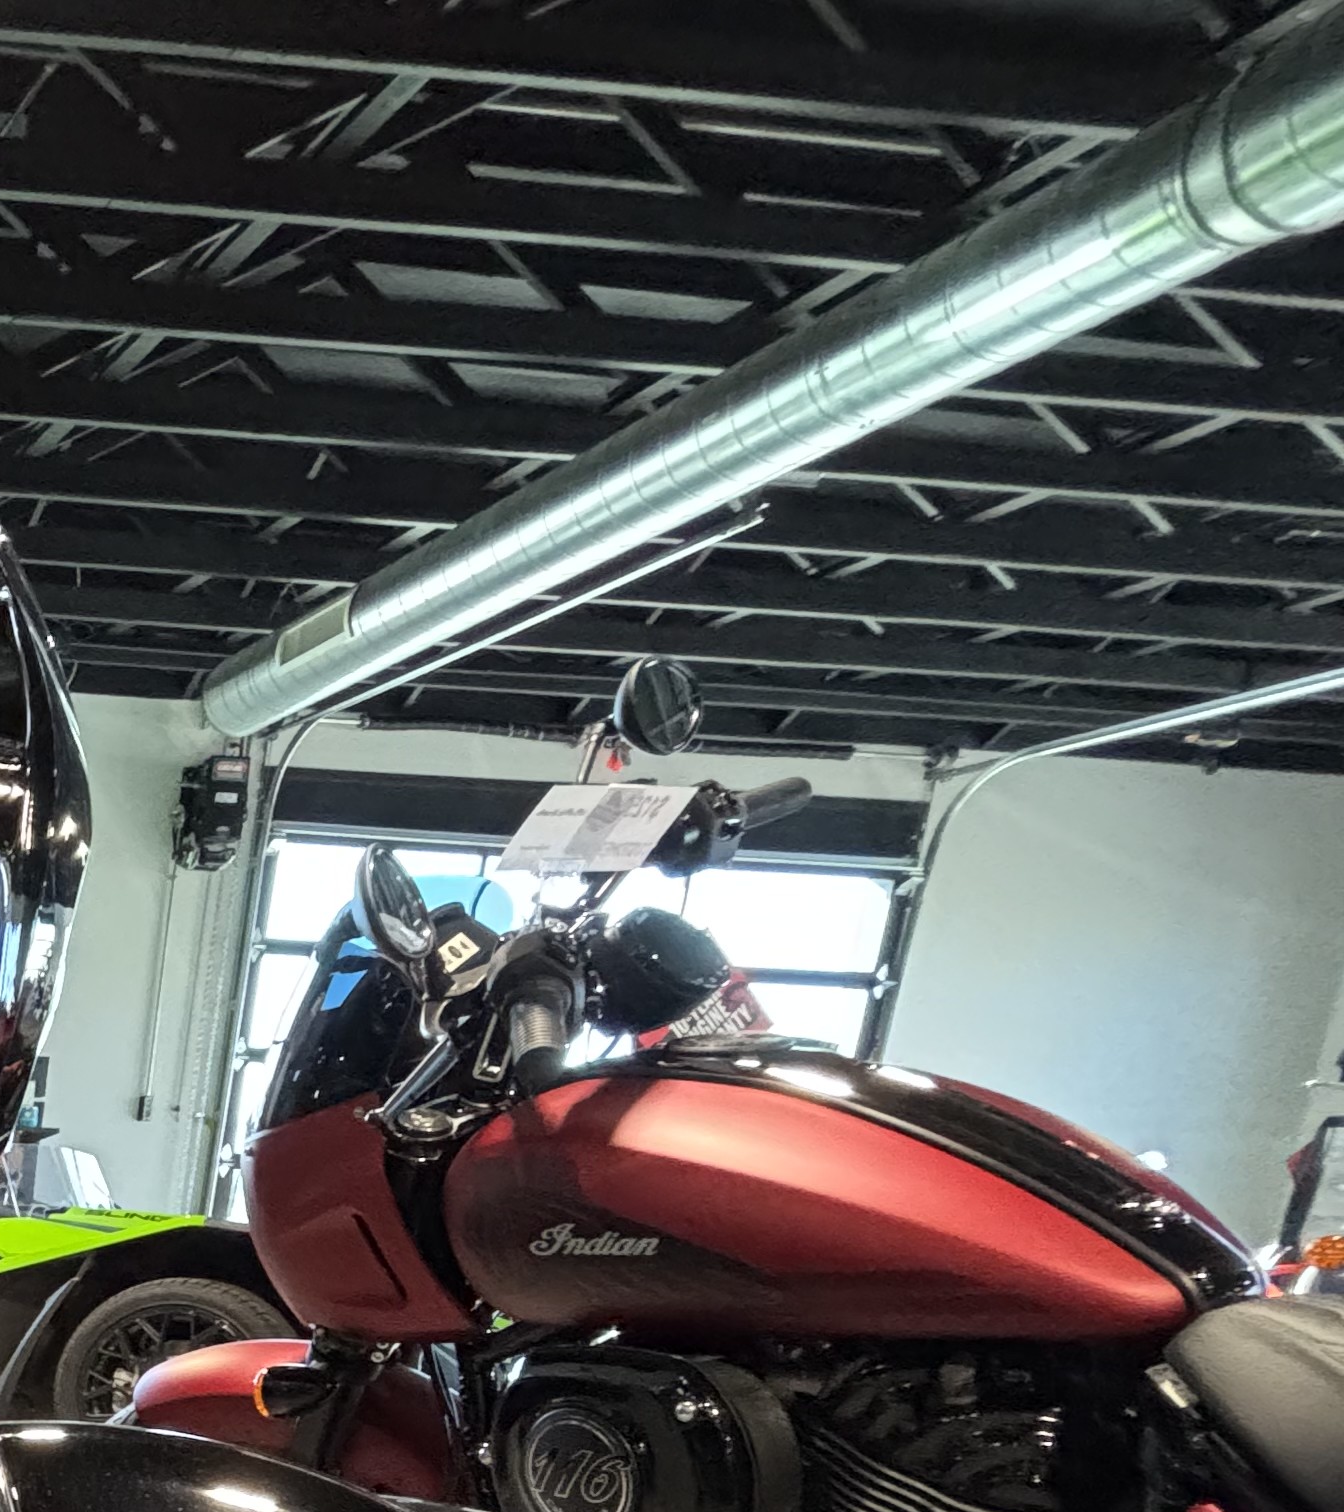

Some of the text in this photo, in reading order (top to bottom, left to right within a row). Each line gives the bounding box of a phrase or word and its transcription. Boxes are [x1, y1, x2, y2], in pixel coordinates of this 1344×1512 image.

[717, 1003, 752, 1033] NTY
[529, 1223, 659, 1256] Indian
[532, 1449, 631, 1503] 116
